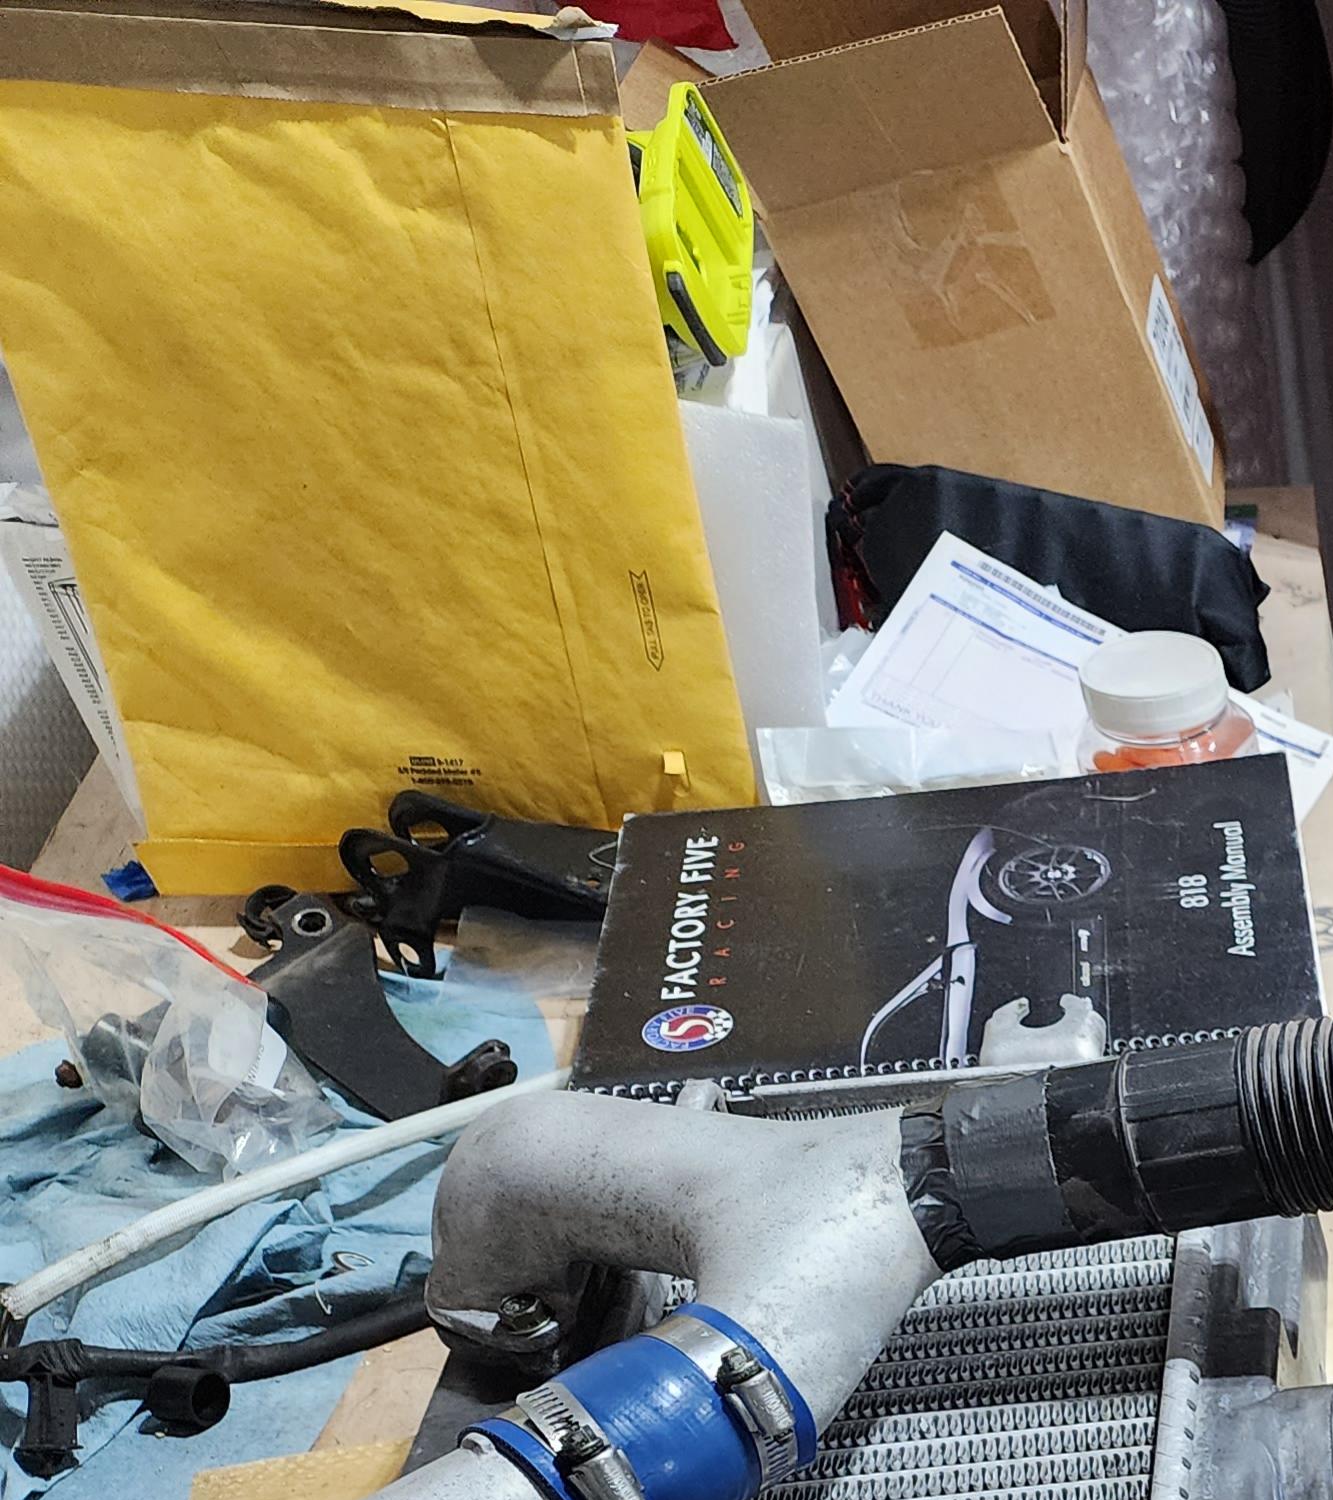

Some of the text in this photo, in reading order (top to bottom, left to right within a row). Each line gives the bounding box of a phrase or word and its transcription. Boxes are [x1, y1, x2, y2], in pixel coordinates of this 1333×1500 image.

[660, 835, 720, 1001] FACTORY FIVE
[708, 841, 746, 987] RACING
[1178, 873, 1210, 909] 818
[1212, 820, 1257, 957] Assembly Manual
